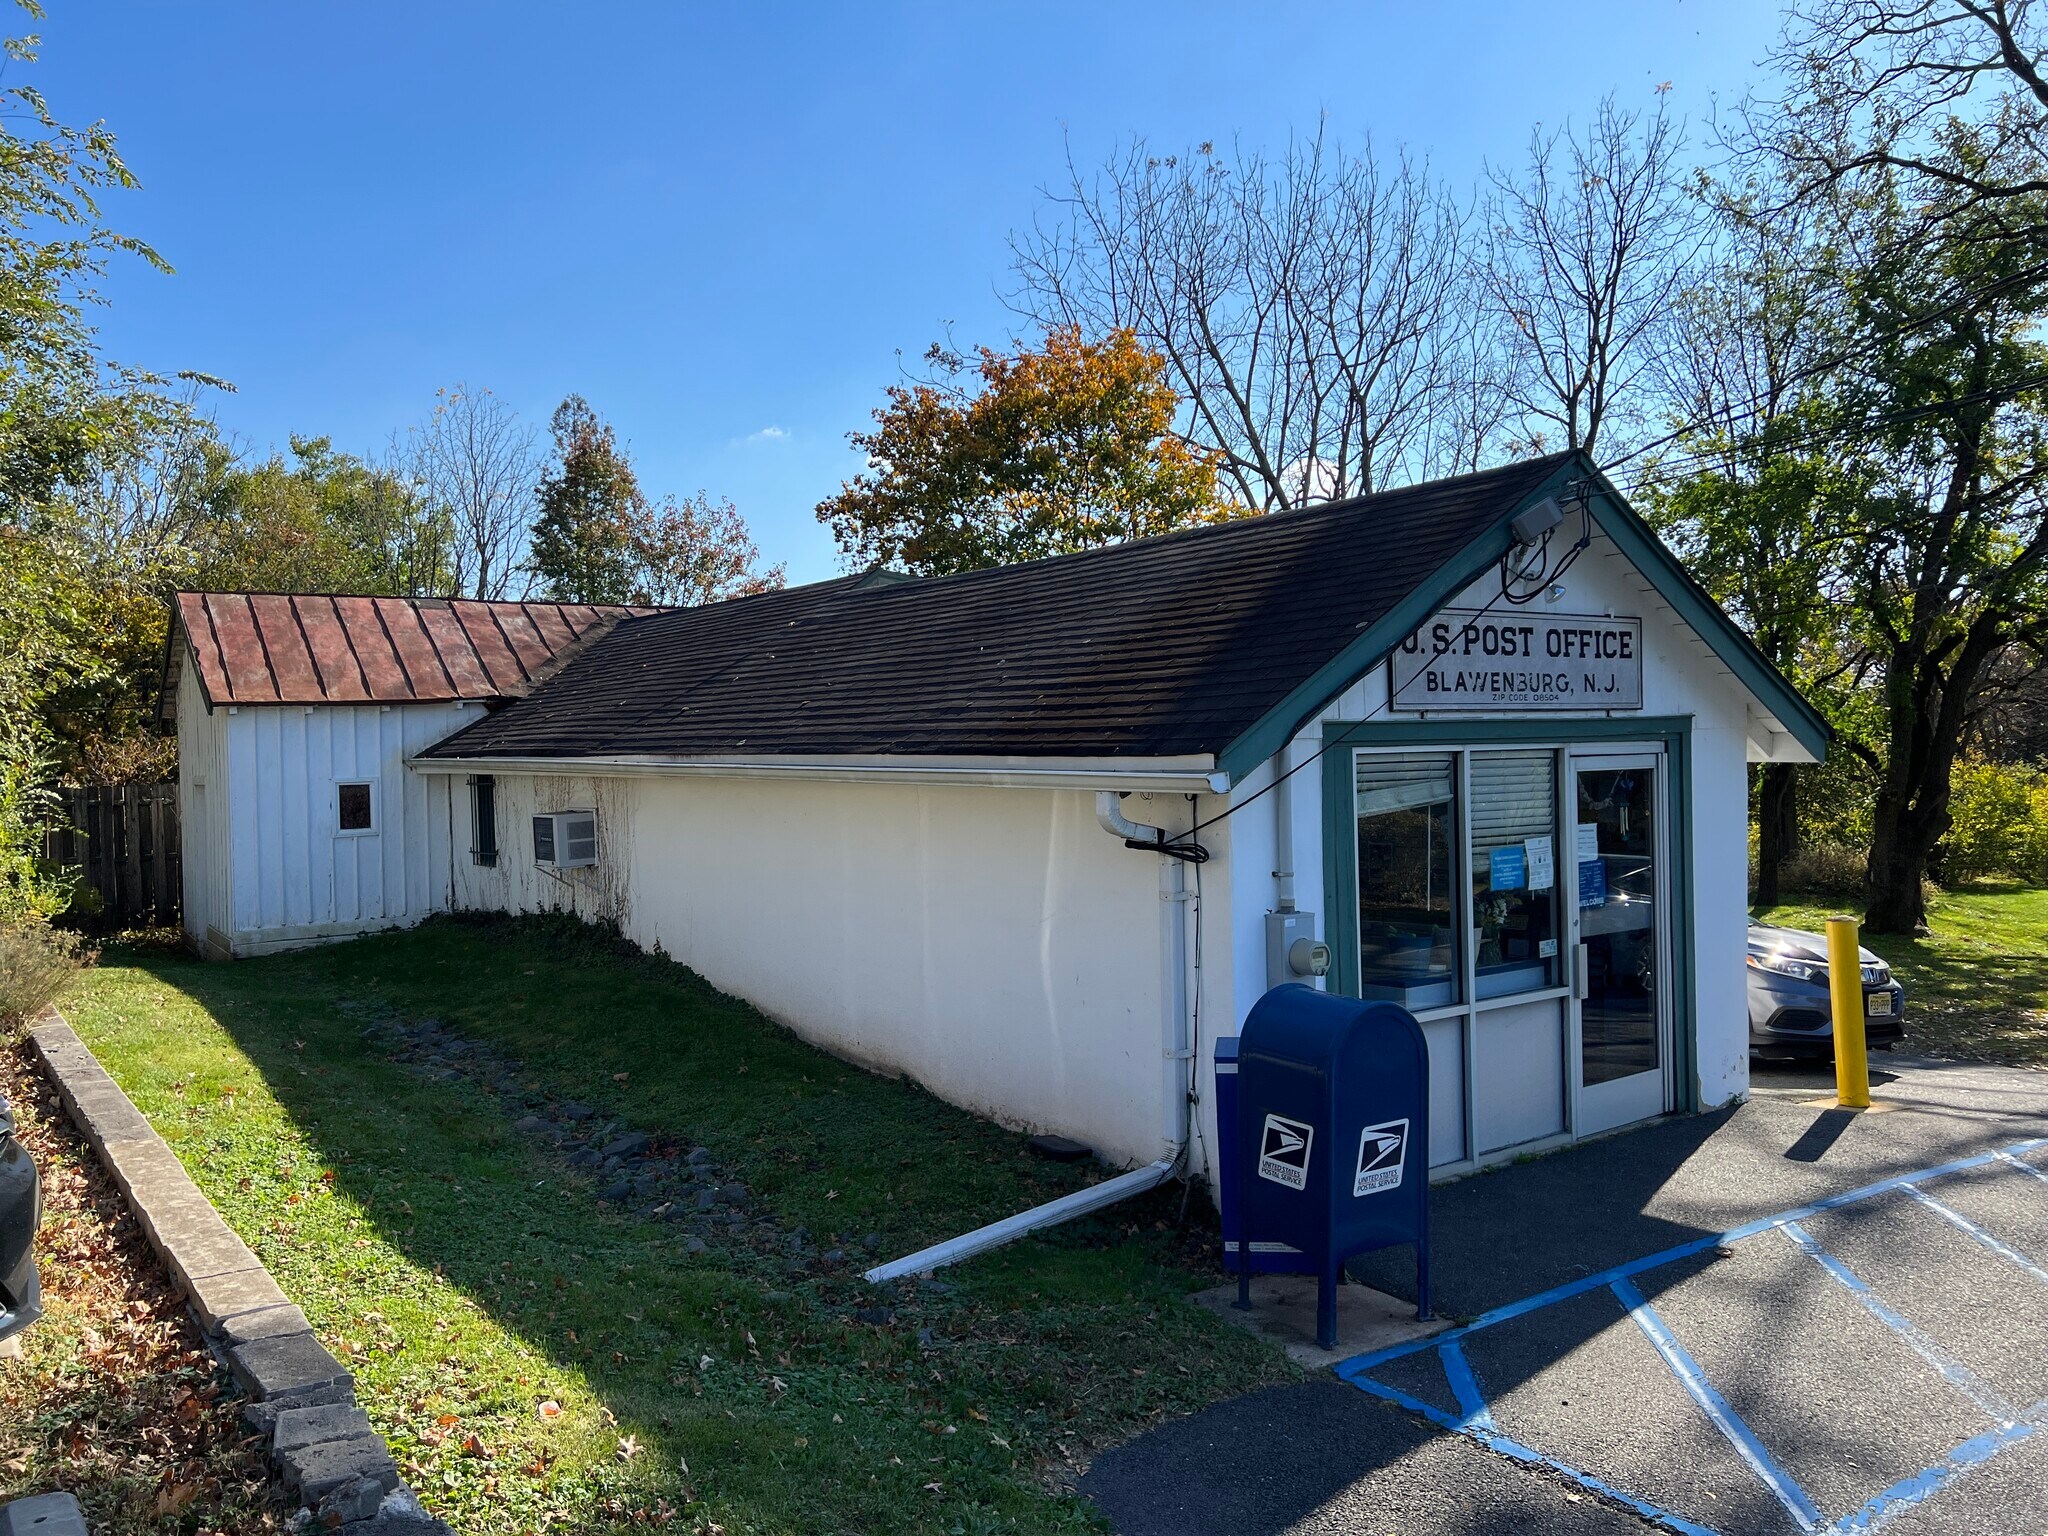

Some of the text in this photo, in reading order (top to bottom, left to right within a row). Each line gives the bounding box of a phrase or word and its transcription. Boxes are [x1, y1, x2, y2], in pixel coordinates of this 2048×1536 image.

[1463, 625, 1533, 658] POST
[1546, 629, 1633, 659] OFFICE
[1426, 671, 1620, 697] BLAWENBURG, N.J.
[1492, 693, 1560, 702] ZIP CODE 08504
[1261, 1167, 1302, 1186] POSTAL SERVICE
[1262, 1160, 1301, 1178] UNITED STATES
[1358, 1169, 1398, 1184] UNITED STATES
[1357, 1176, 1399, 1192] POSTAL SERVICE
